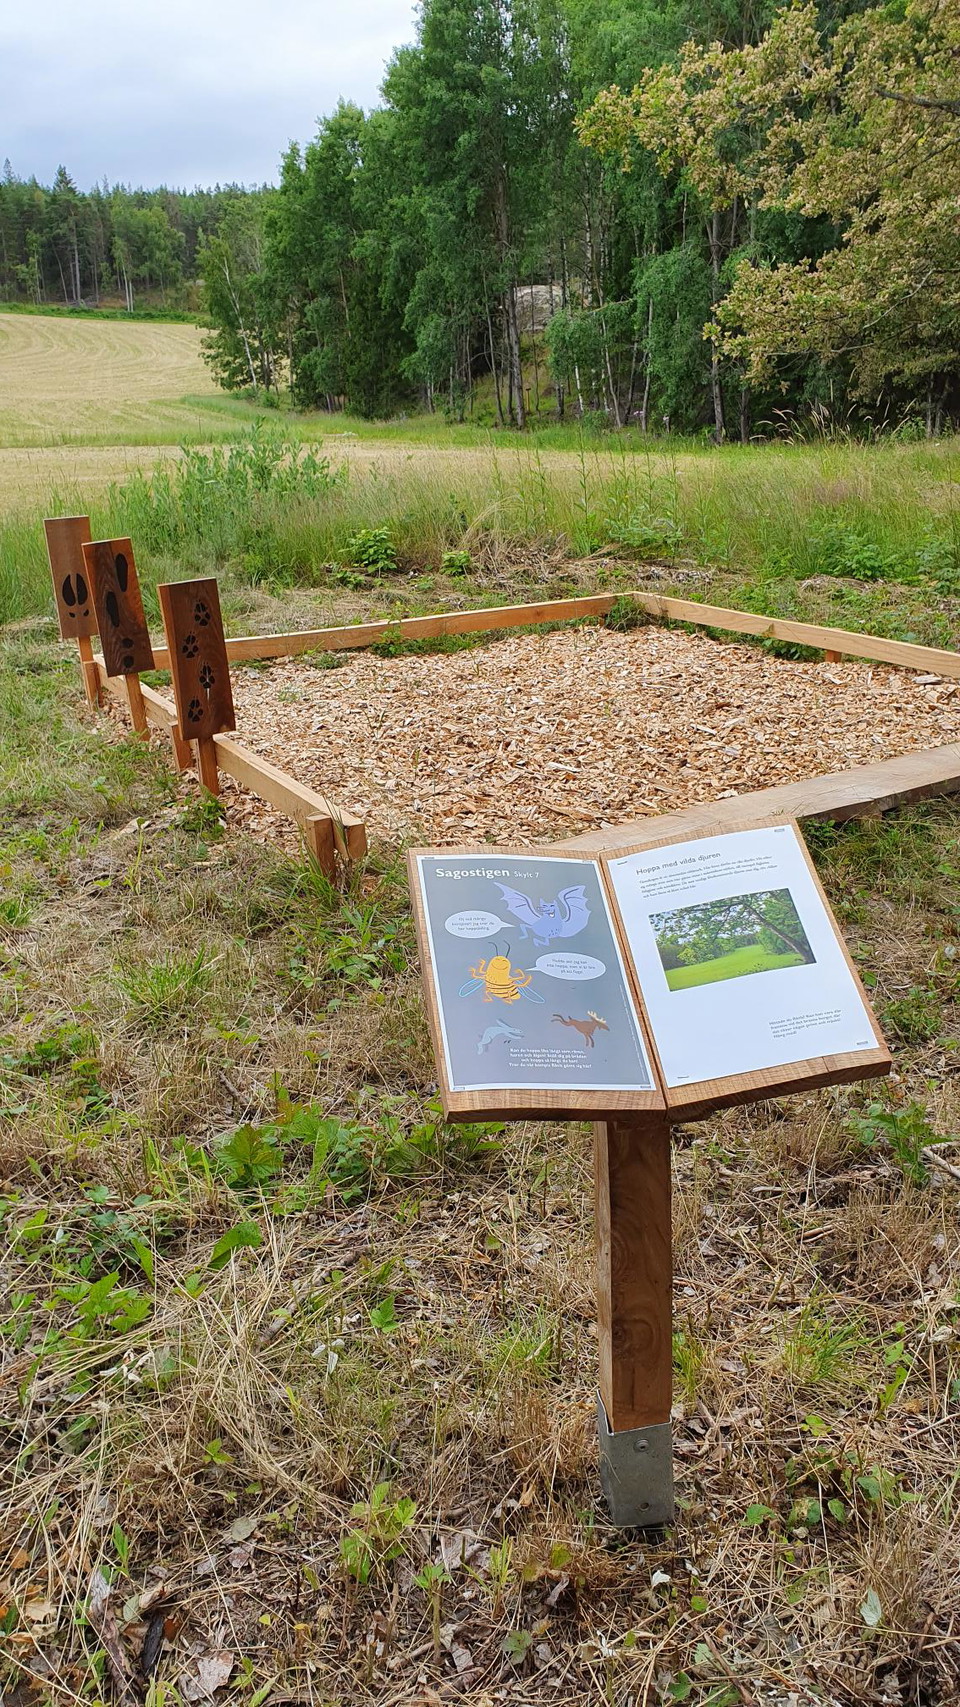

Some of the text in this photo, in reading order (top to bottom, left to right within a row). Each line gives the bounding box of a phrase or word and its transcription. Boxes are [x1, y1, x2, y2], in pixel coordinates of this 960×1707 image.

[636, 852, 721, 875] Hoppa med vilda djuren
[436, 868, 510, 879] Sagostigen
[514, 870, 533, 879] Skylt
